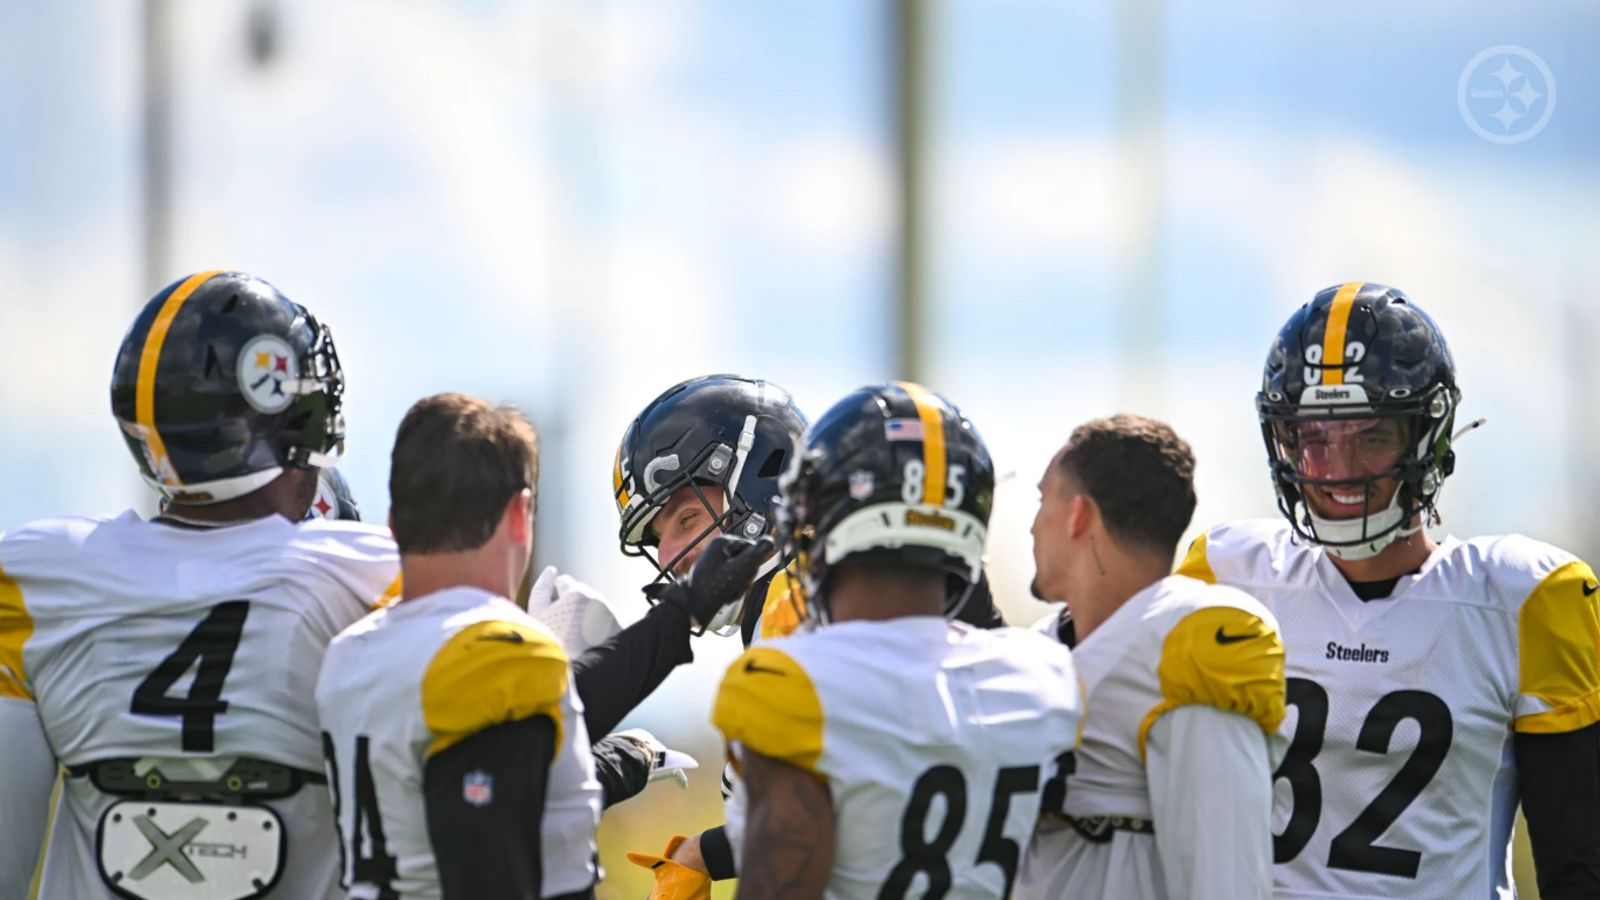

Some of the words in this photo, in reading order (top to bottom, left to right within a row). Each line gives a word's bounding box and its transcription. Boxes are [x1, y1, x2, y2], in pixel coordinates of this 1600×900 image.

[902, 459, 965, 510] 85
[130, 601, 250, 752] 4
[1326, 641, 1389, 663] Steelers
[877, 764, 1041, 900] 85
